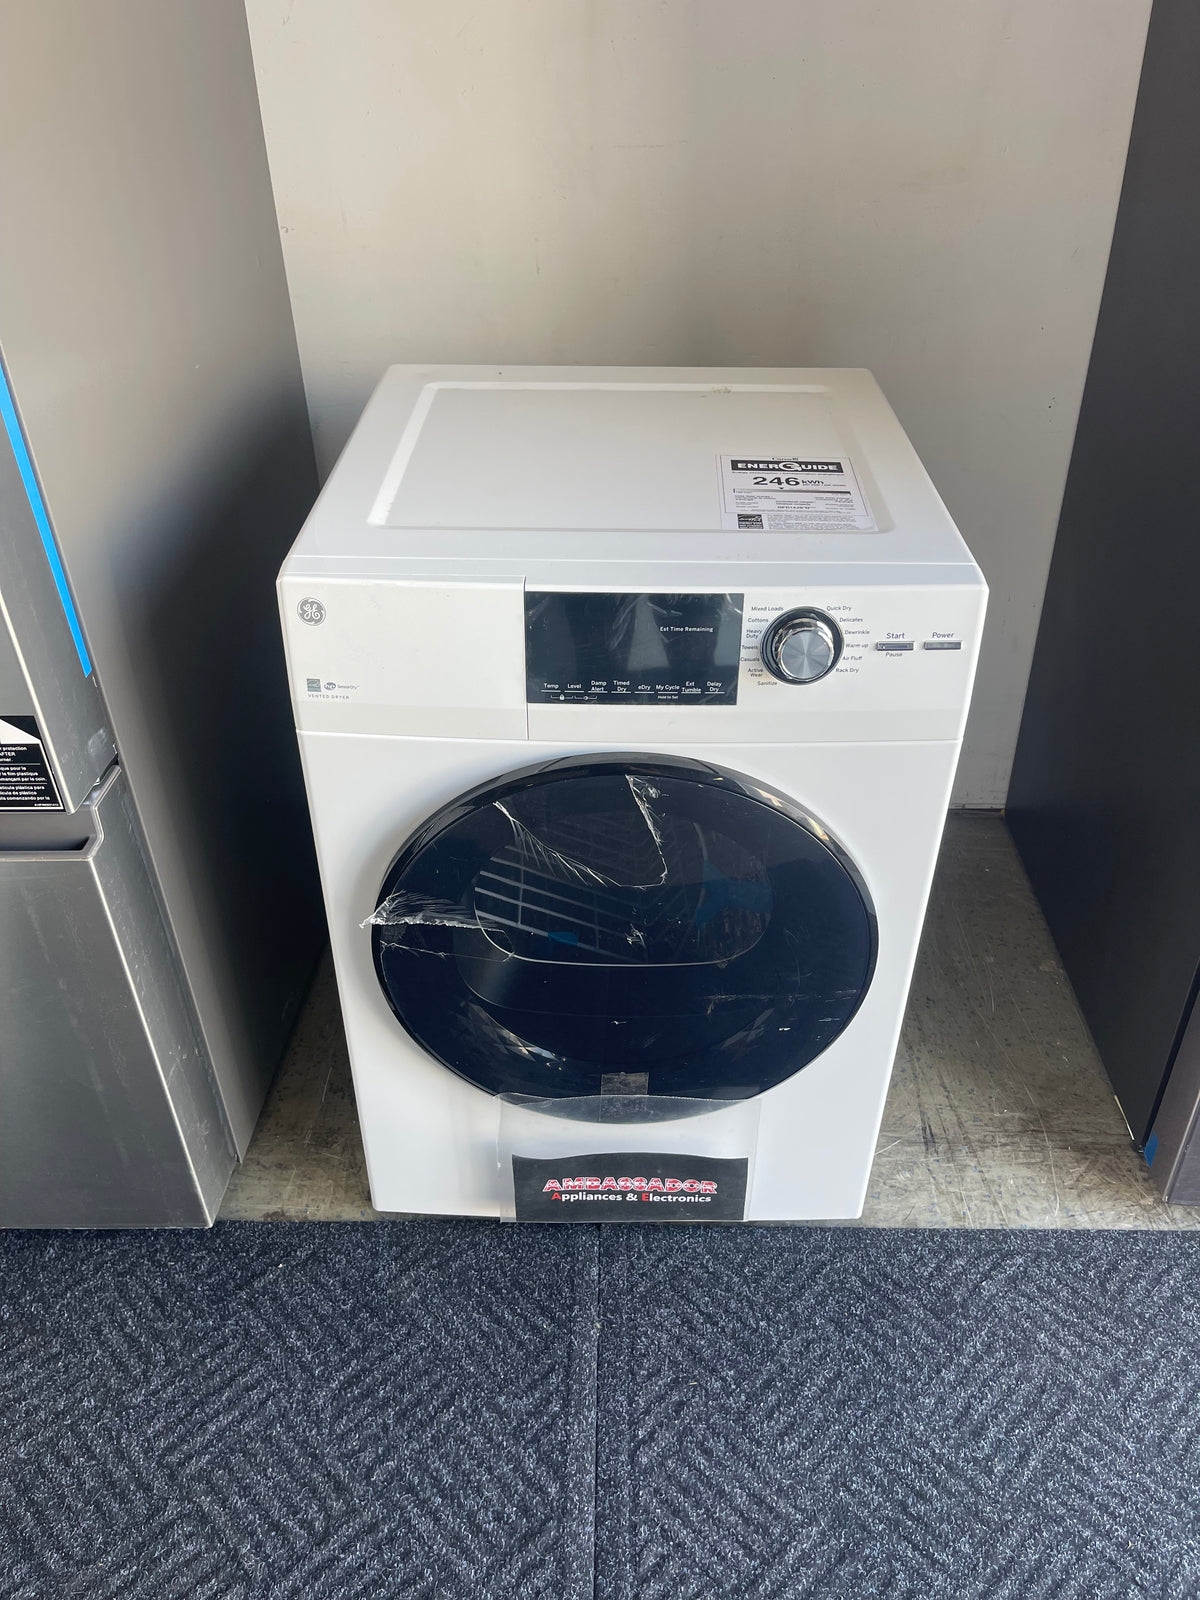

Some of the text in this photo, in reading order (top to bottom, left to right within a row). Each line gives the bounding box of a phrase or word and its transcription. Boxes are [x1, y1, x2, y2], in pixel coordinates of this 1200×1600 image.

[736, 461, 839, 472] ENERGUIDE
[753, 476, 800, 487] 246
[931, 631, 955, 639] Power
[543, 1177, 718, 1193] AMBASSADOR
[551, 1192, 712, 1203] Appliances & Electronics
